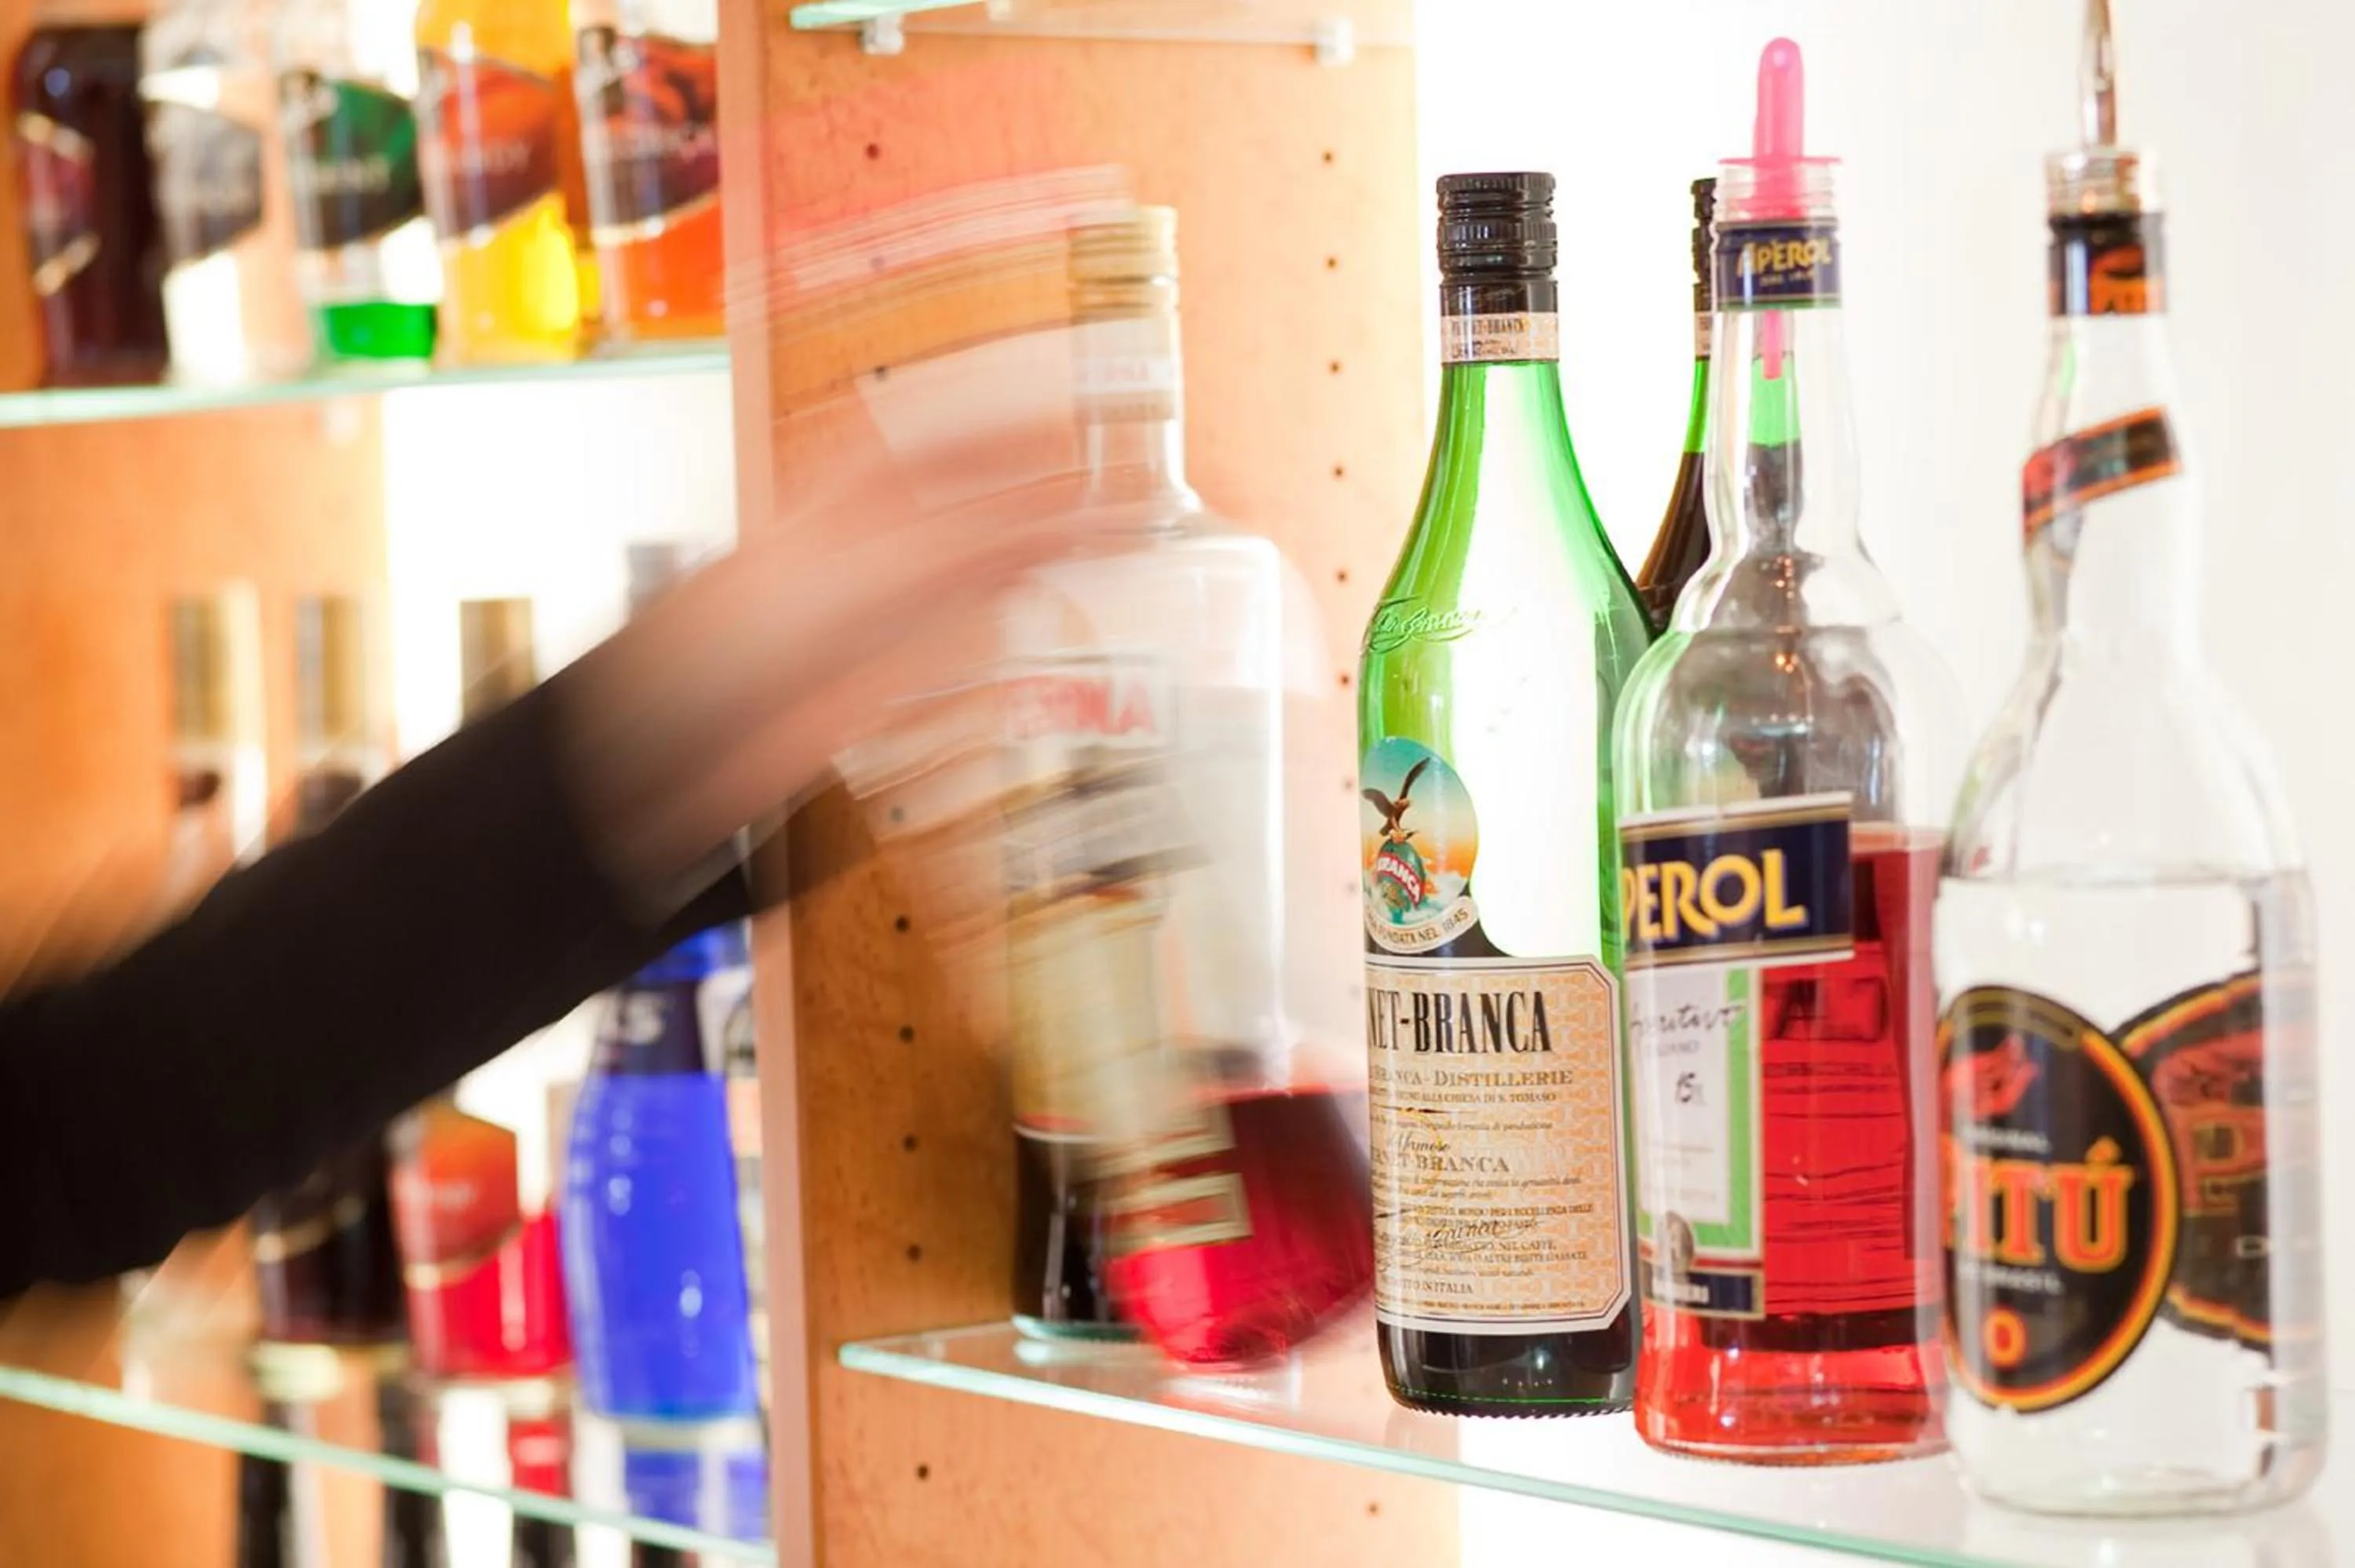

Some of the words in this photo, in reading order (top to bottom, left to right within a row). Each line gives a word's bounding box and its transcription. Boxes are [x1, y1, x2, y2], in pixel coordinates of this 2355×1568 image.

[1736, 238, 1832, 278] APEROL
[1622, 849, 1808, 942] PEROL
[1434, 1281, 1474, 1294] ITALIA
